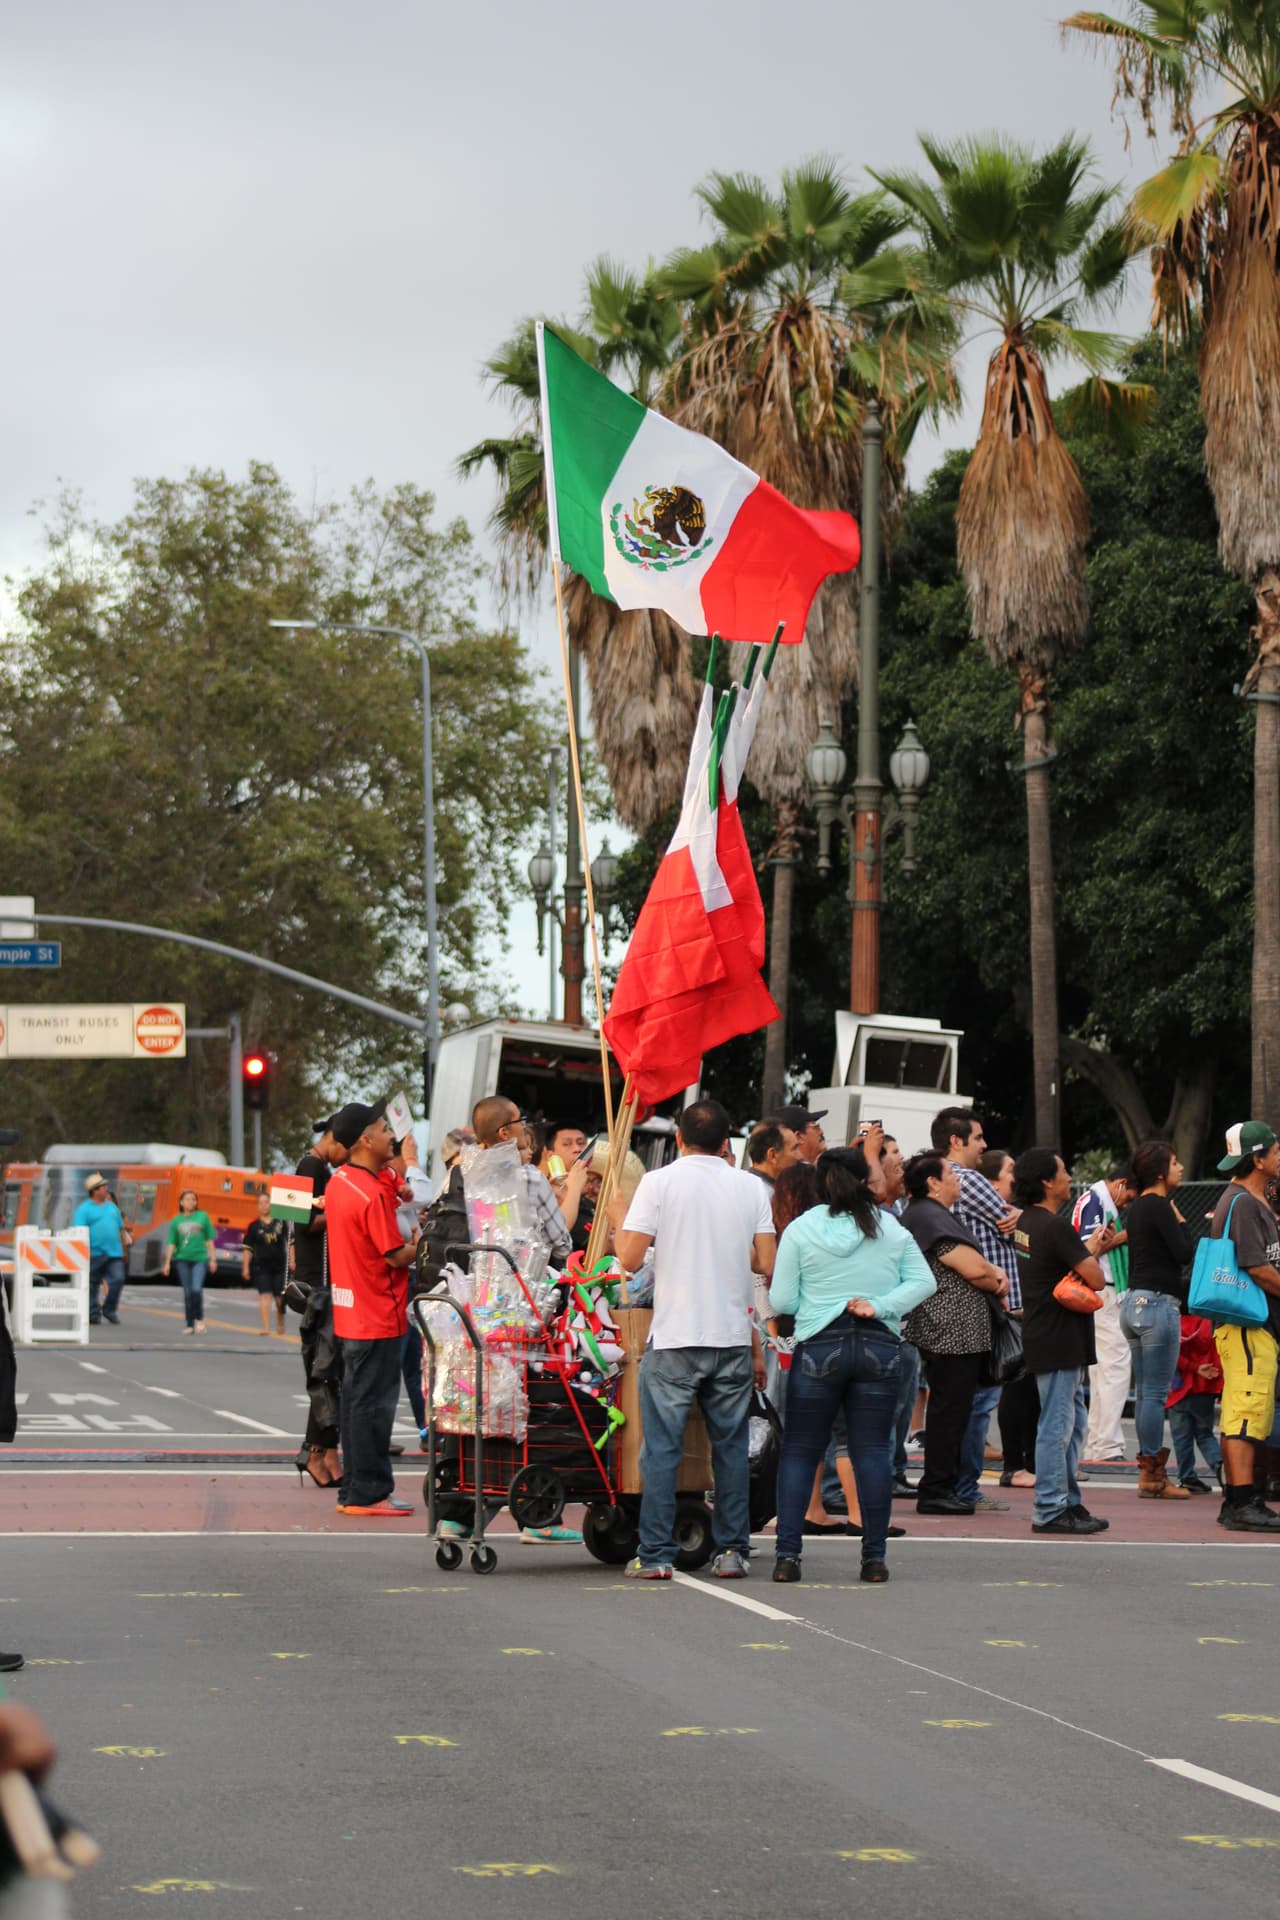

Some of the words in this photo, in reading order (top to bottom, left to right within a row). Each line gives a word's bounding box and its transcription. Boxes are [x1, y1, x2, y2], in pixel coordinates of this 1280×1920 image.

[38, 947, 53, 961] St
[21, 1016, 70, 1028] TRANSIT
[80, 1016, 120, 1028] BUSES
[143, 1014, 156, 1025] DO
[158, 1014, 177, 1025] NOT
[56, 1034, 86, 1045] ONLY
[144, 1037, 175, 1049] ENTER
